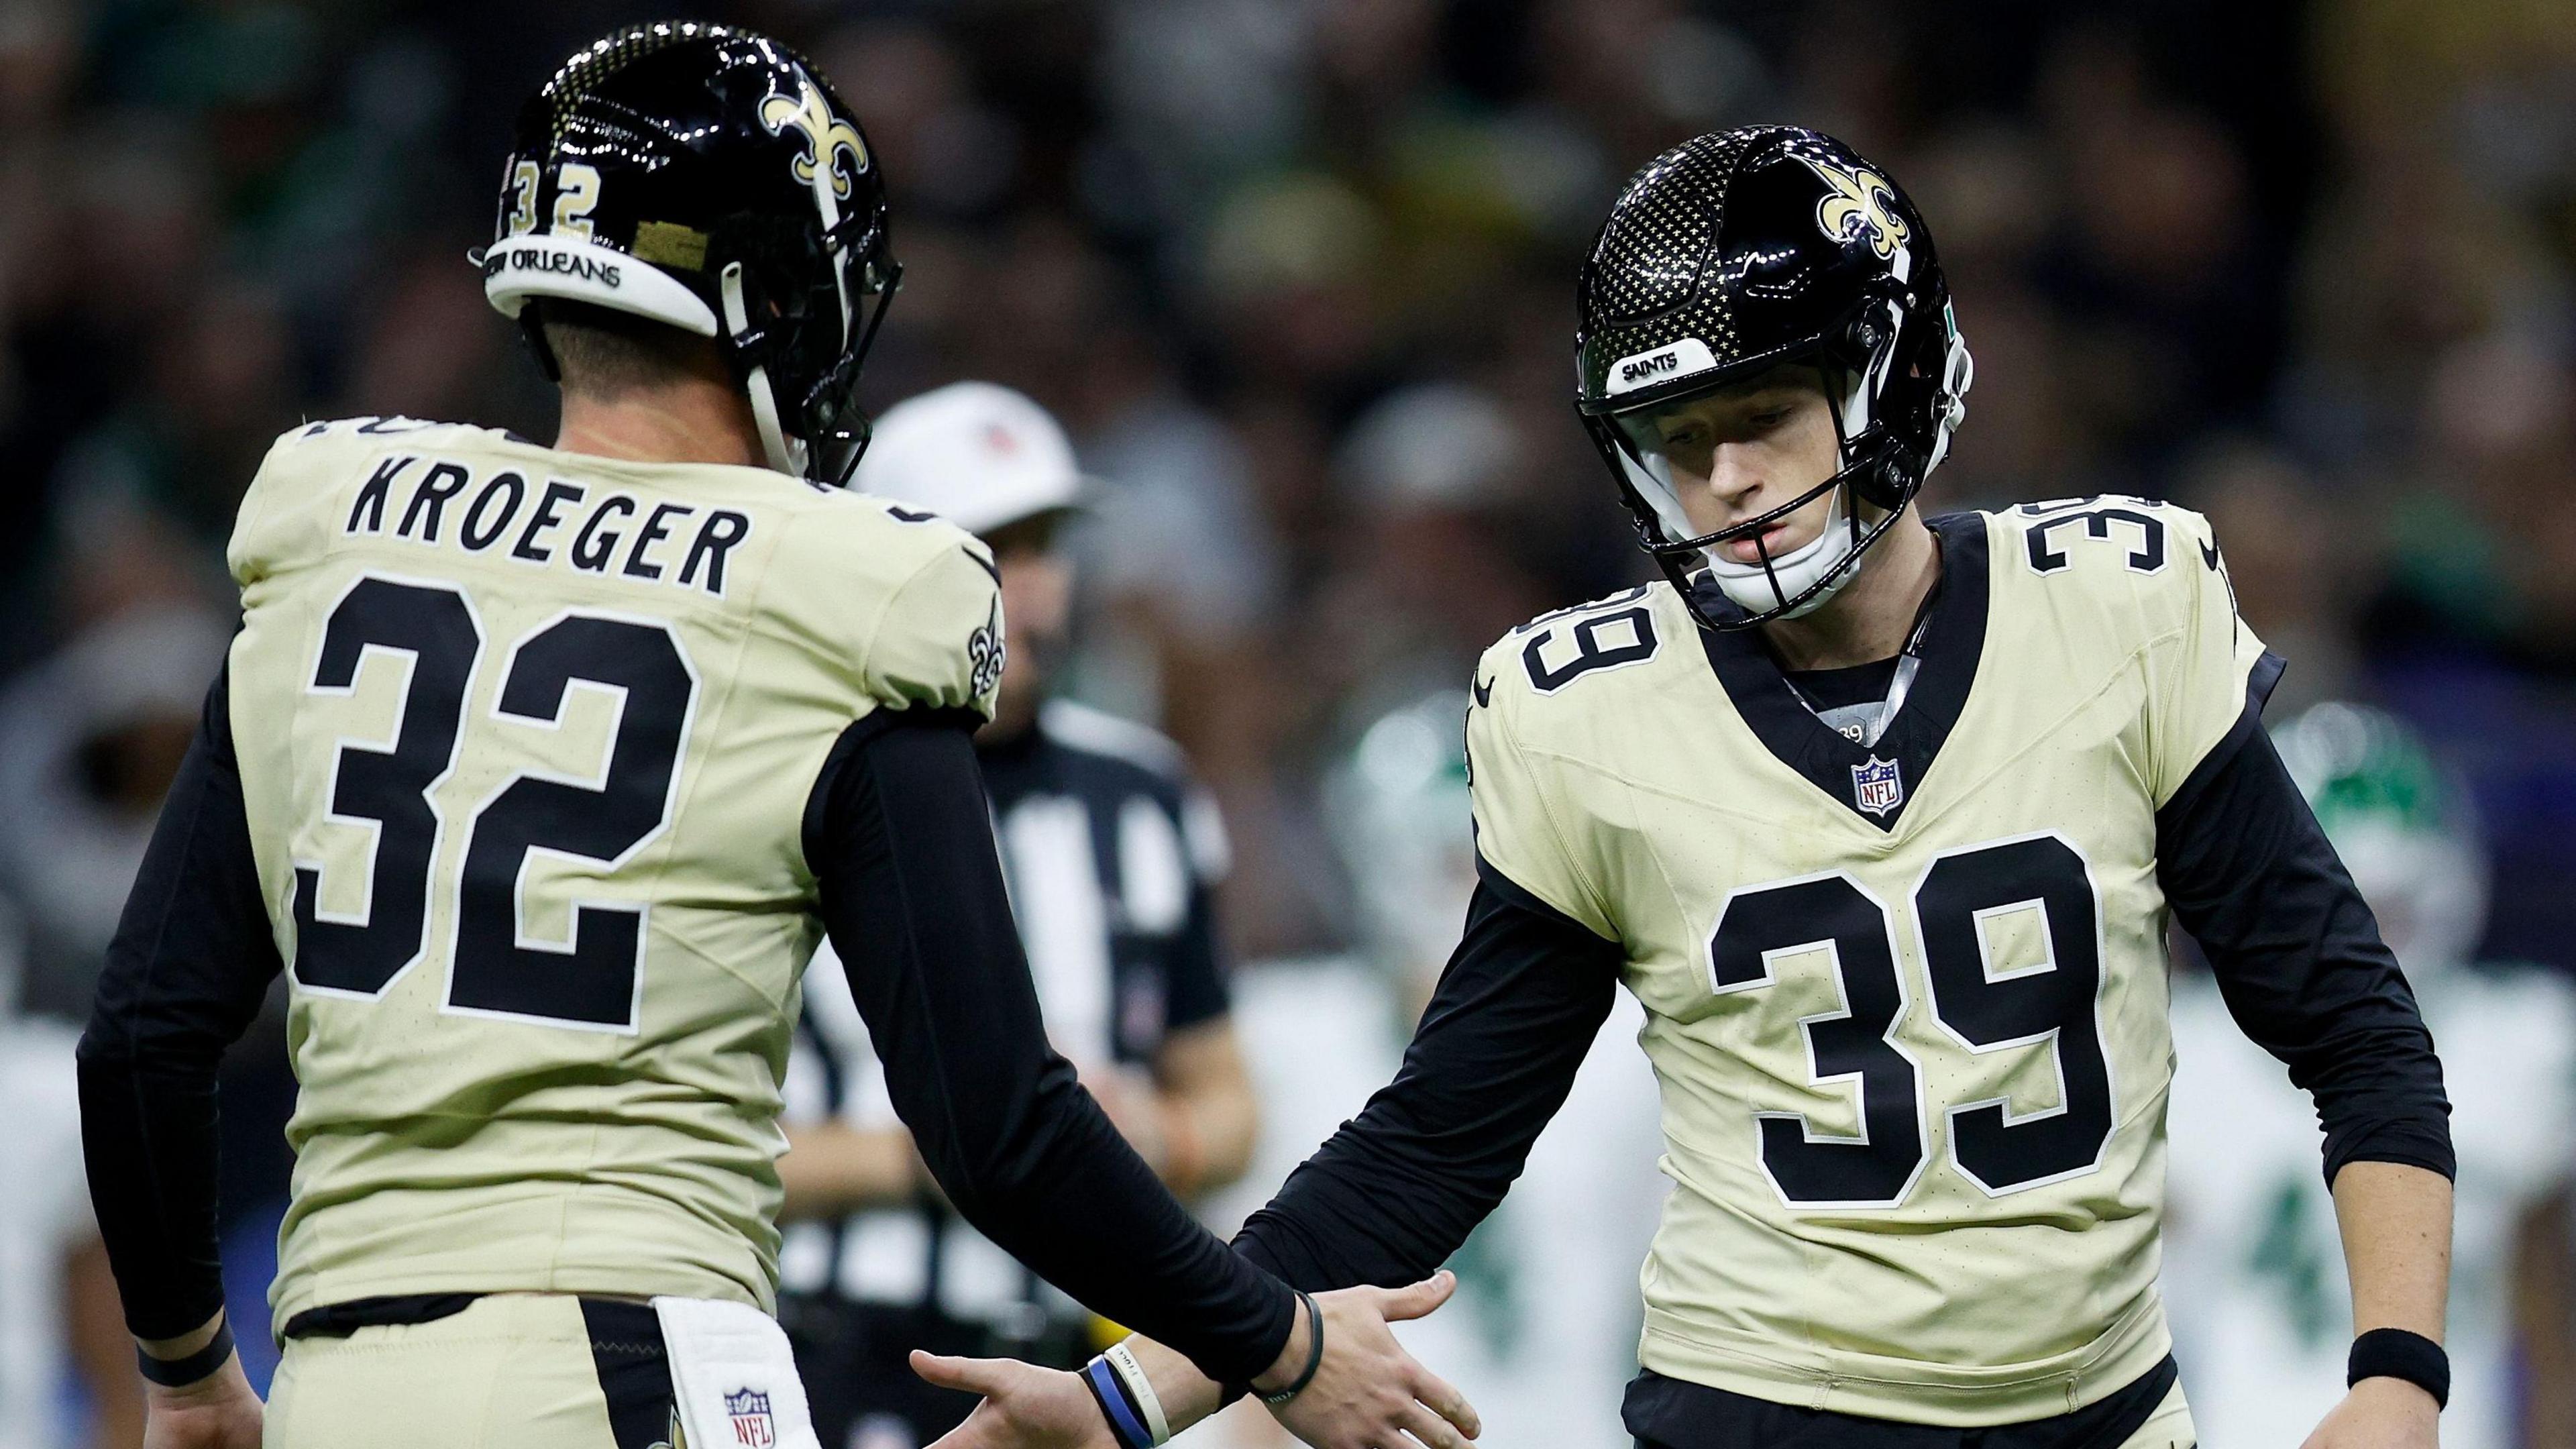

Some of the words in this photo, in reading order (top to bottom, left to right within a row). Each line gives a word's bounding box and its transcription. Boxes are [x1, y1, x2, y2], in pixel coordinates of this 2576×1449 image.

[509, 160, 601, 242] 32
[1622, 352, 1677, 382] SAINTS
[344, 453, 753, 600] KROEGER
[290, 569, 702, 1036] 32
[1862, 782, 1896, 805] NFL
[1705, 828, 2118, 1210] 39
[732, 1417, 771, 1448] NFL
